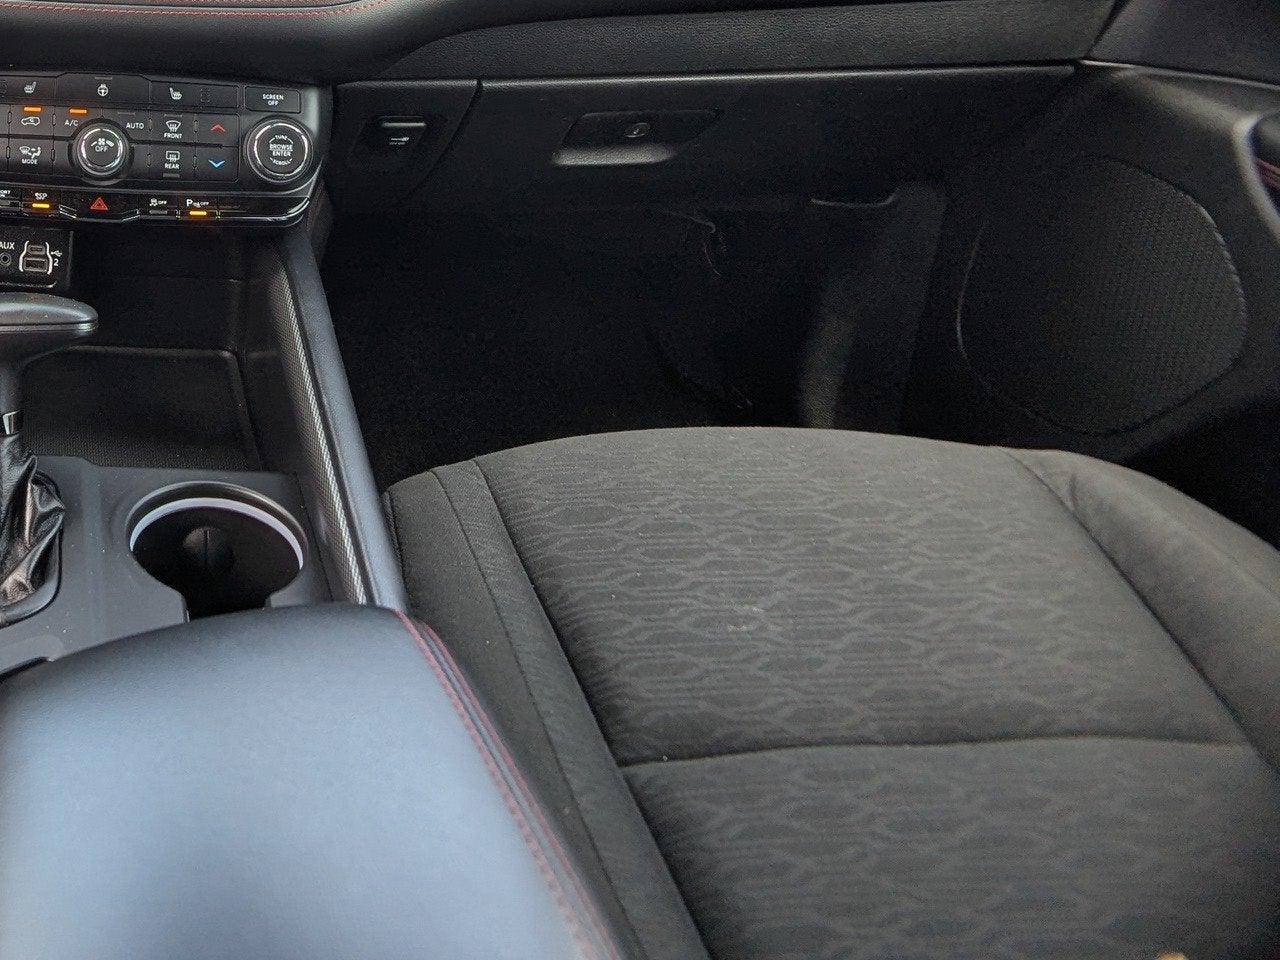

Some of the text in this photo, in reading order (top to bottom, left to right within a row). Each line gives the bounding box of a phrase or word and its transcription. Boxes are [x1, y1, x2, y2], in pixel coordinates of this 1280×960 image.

[64, 119, 79, 127] A/C
[125, 122, 145, 130] AUTO
[94, 145, 109, 153] OFF
[164, 162, 180, 170] REAR
[53, 258, 59, 267] 2
